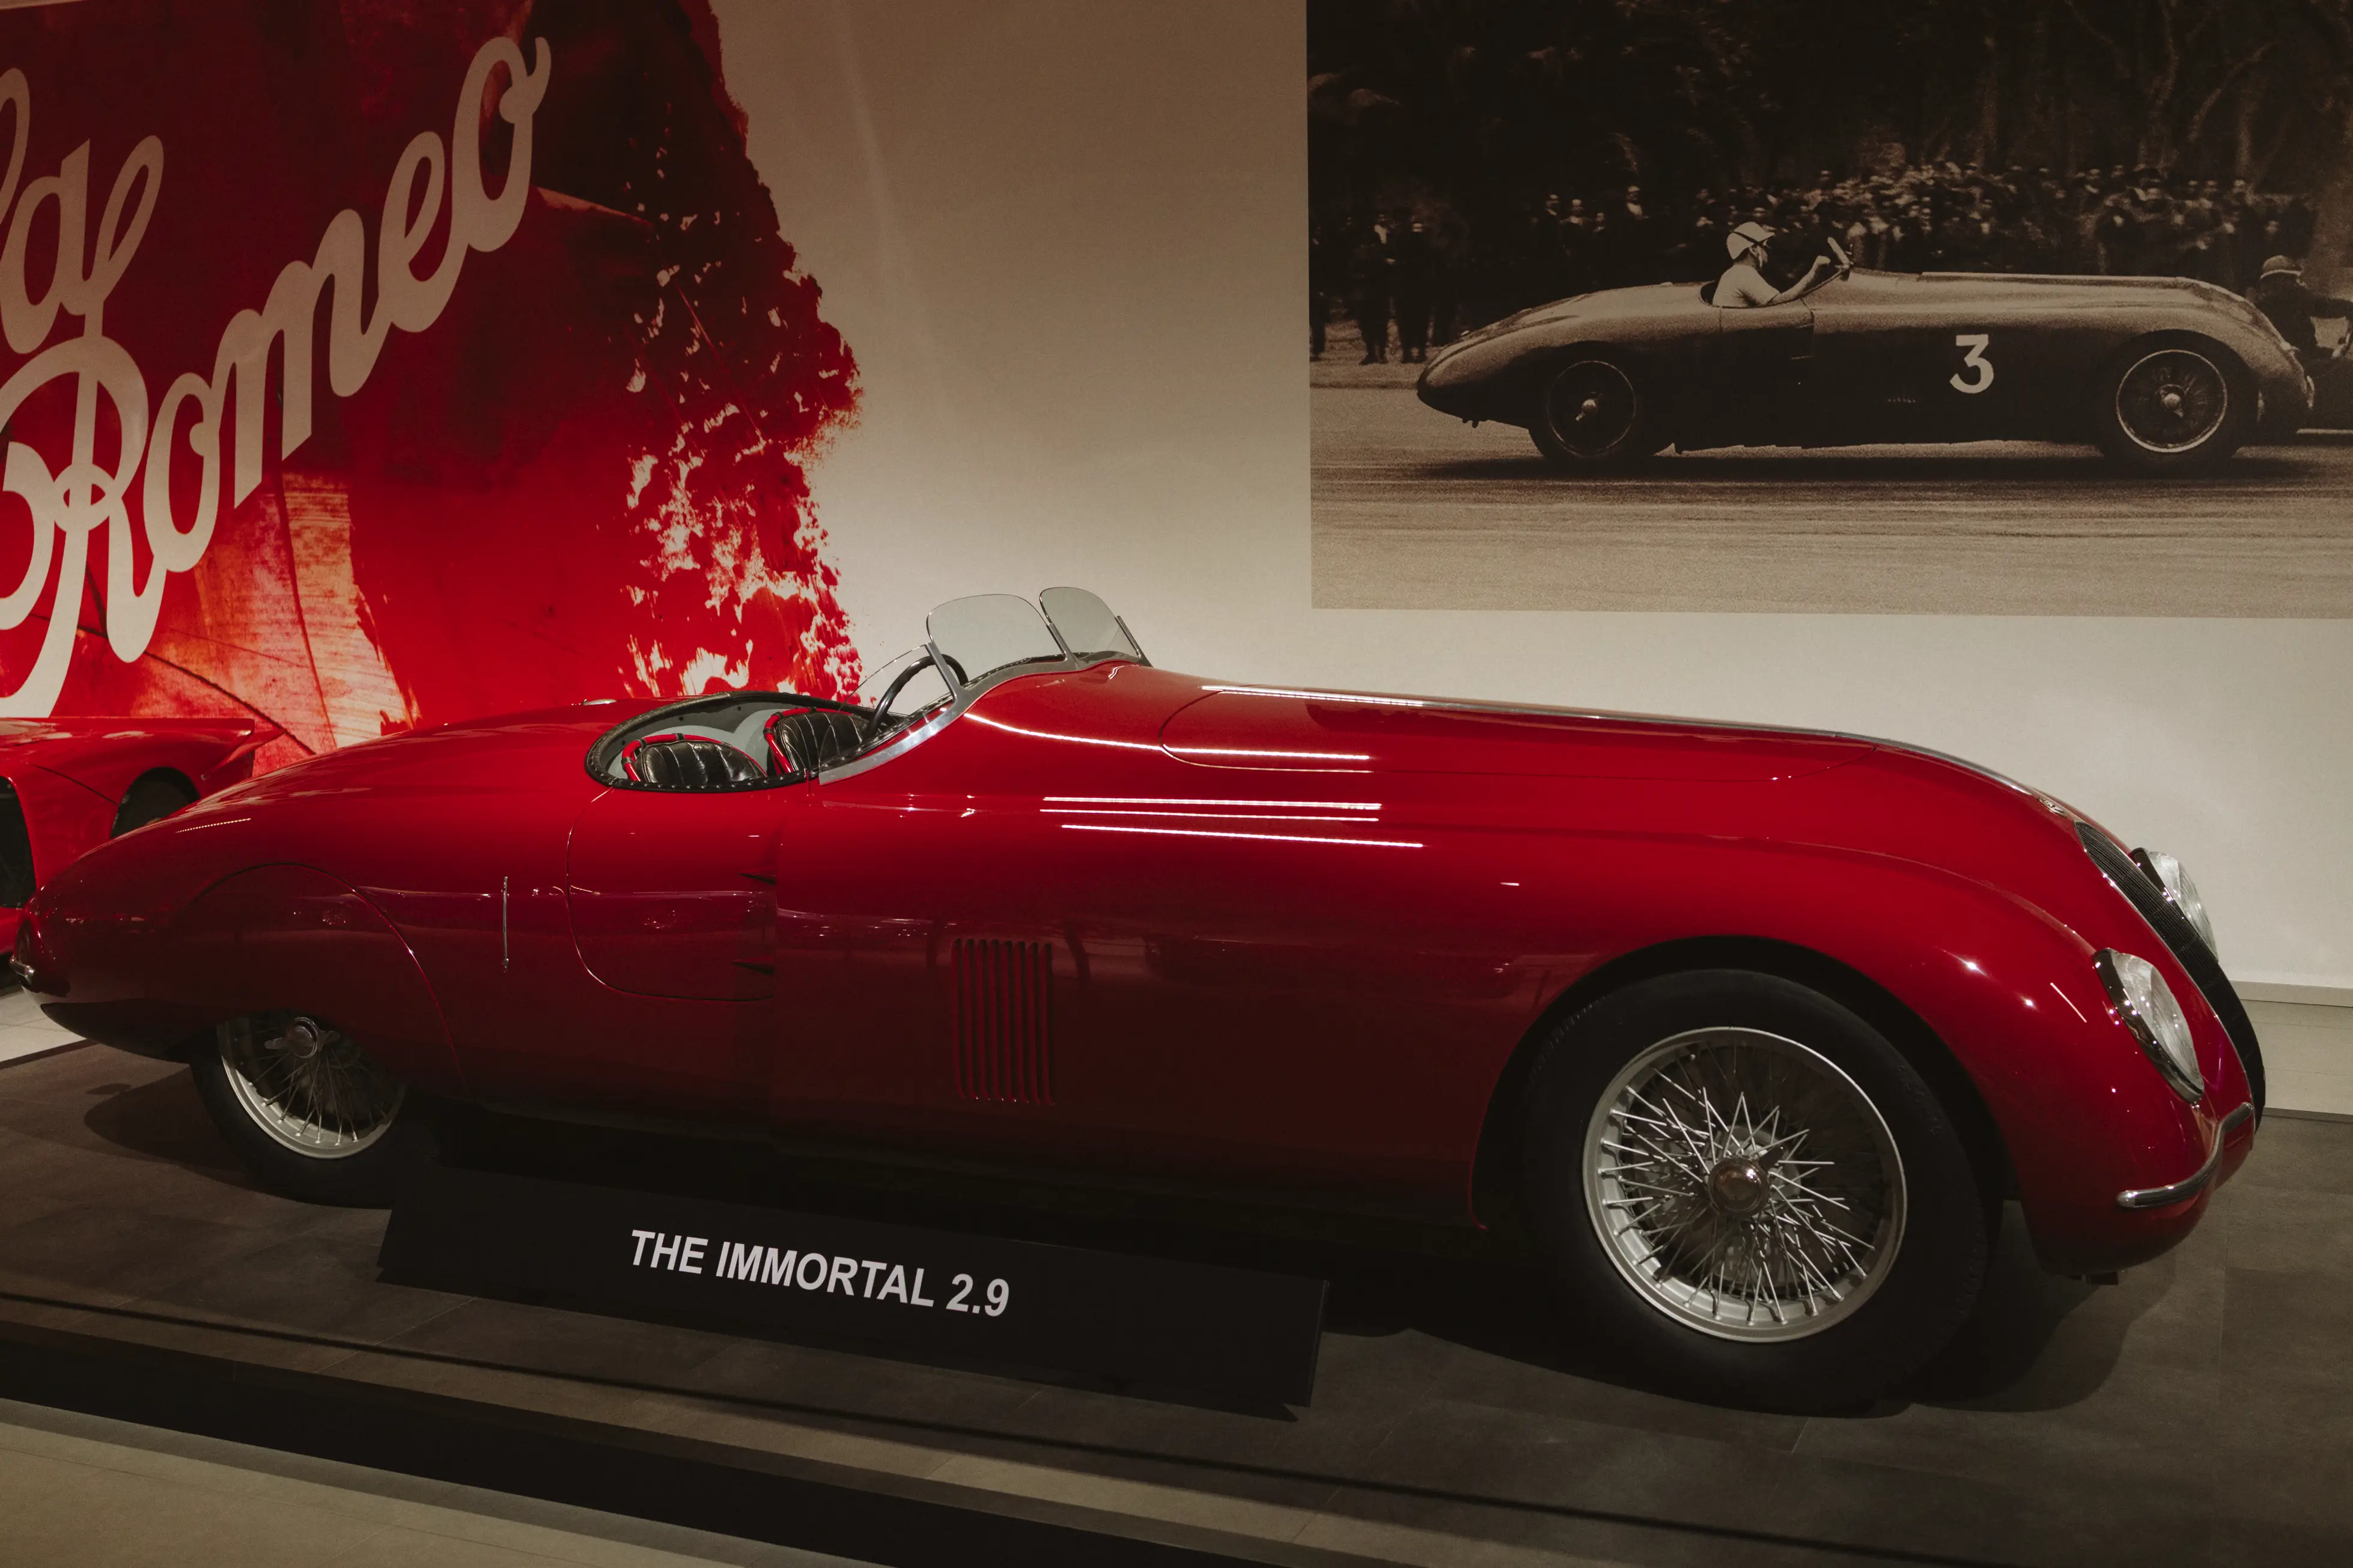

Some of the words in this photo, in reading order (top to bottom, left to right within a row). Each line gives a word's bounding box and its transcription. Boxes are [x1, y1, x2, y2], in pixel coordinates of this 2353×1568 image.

[0, 36, 551, 718] Romeo
[1950, 333, 1994, 394] 3
[632, 1229, 709, 1274] THE
[716, 1241, 934, 1307] IMMORTAL
[946, 1273, 1009, 1317] 2.9
